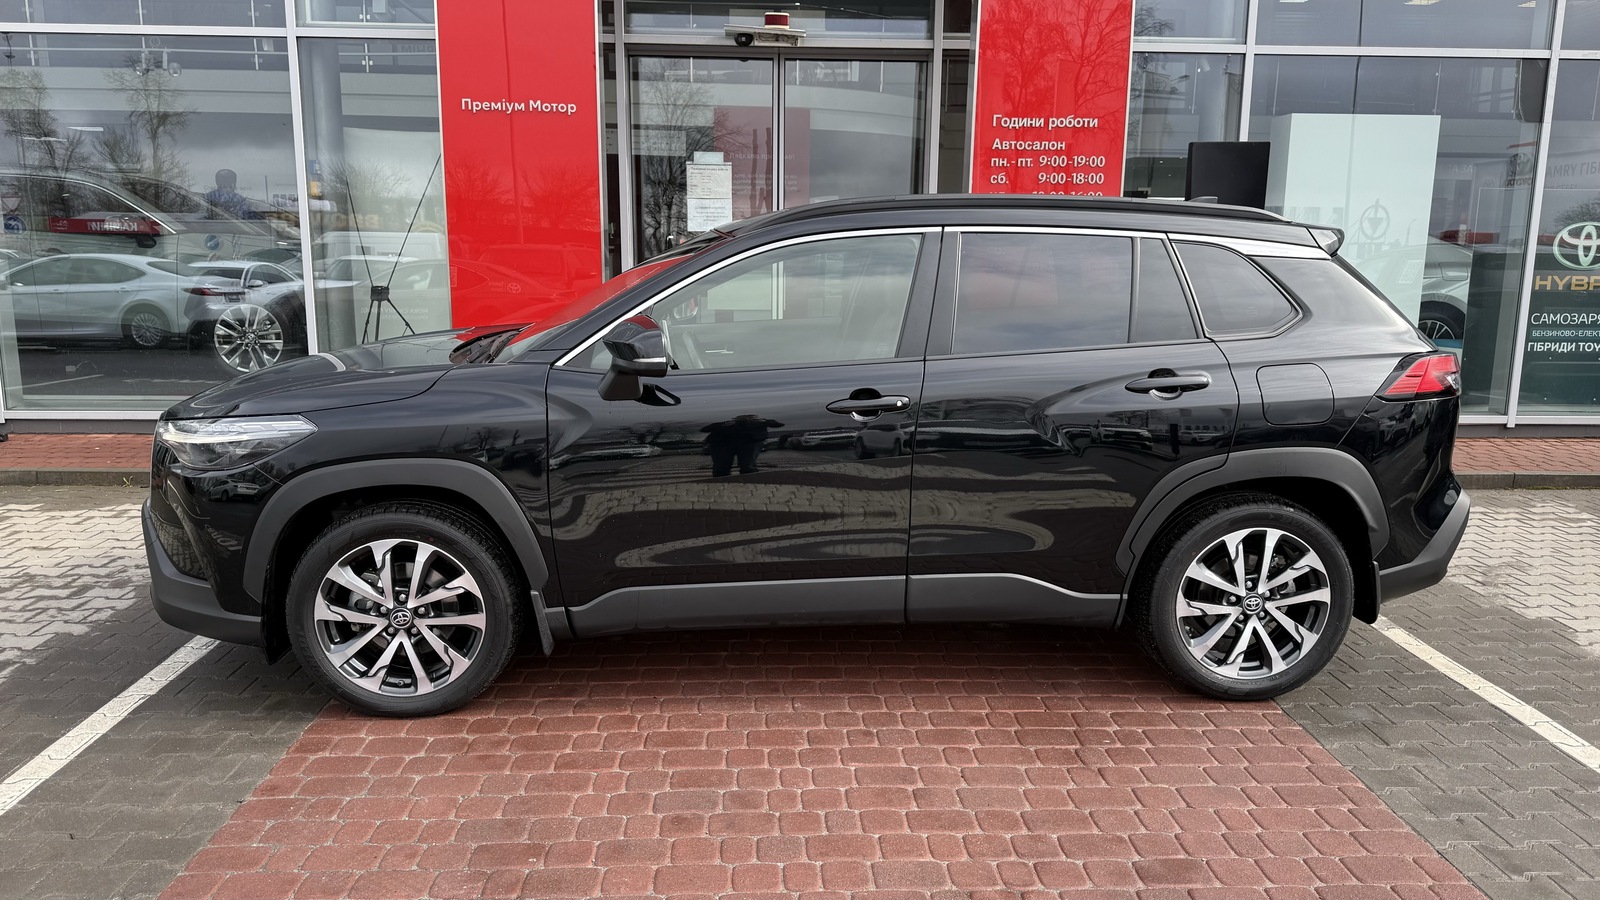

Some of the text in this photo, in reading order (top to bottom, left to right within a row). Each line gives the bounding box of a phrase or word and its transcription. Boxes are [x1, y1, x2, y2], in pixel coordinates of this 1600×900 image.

[461, 98, 577, 115] Преміум Мотор
[992, 114, 1098, 130] Години роботи
[992, 138, 1066, 150] Автосалон
[1039, 155, 1106, 168] 9:00-19:00
[1546, 163, 1577, 178] AMRY
[990, 172, 1105, 185] сб. 9:00-18:00
[1527, 342, 1576, 354] ГІБРИДИ
